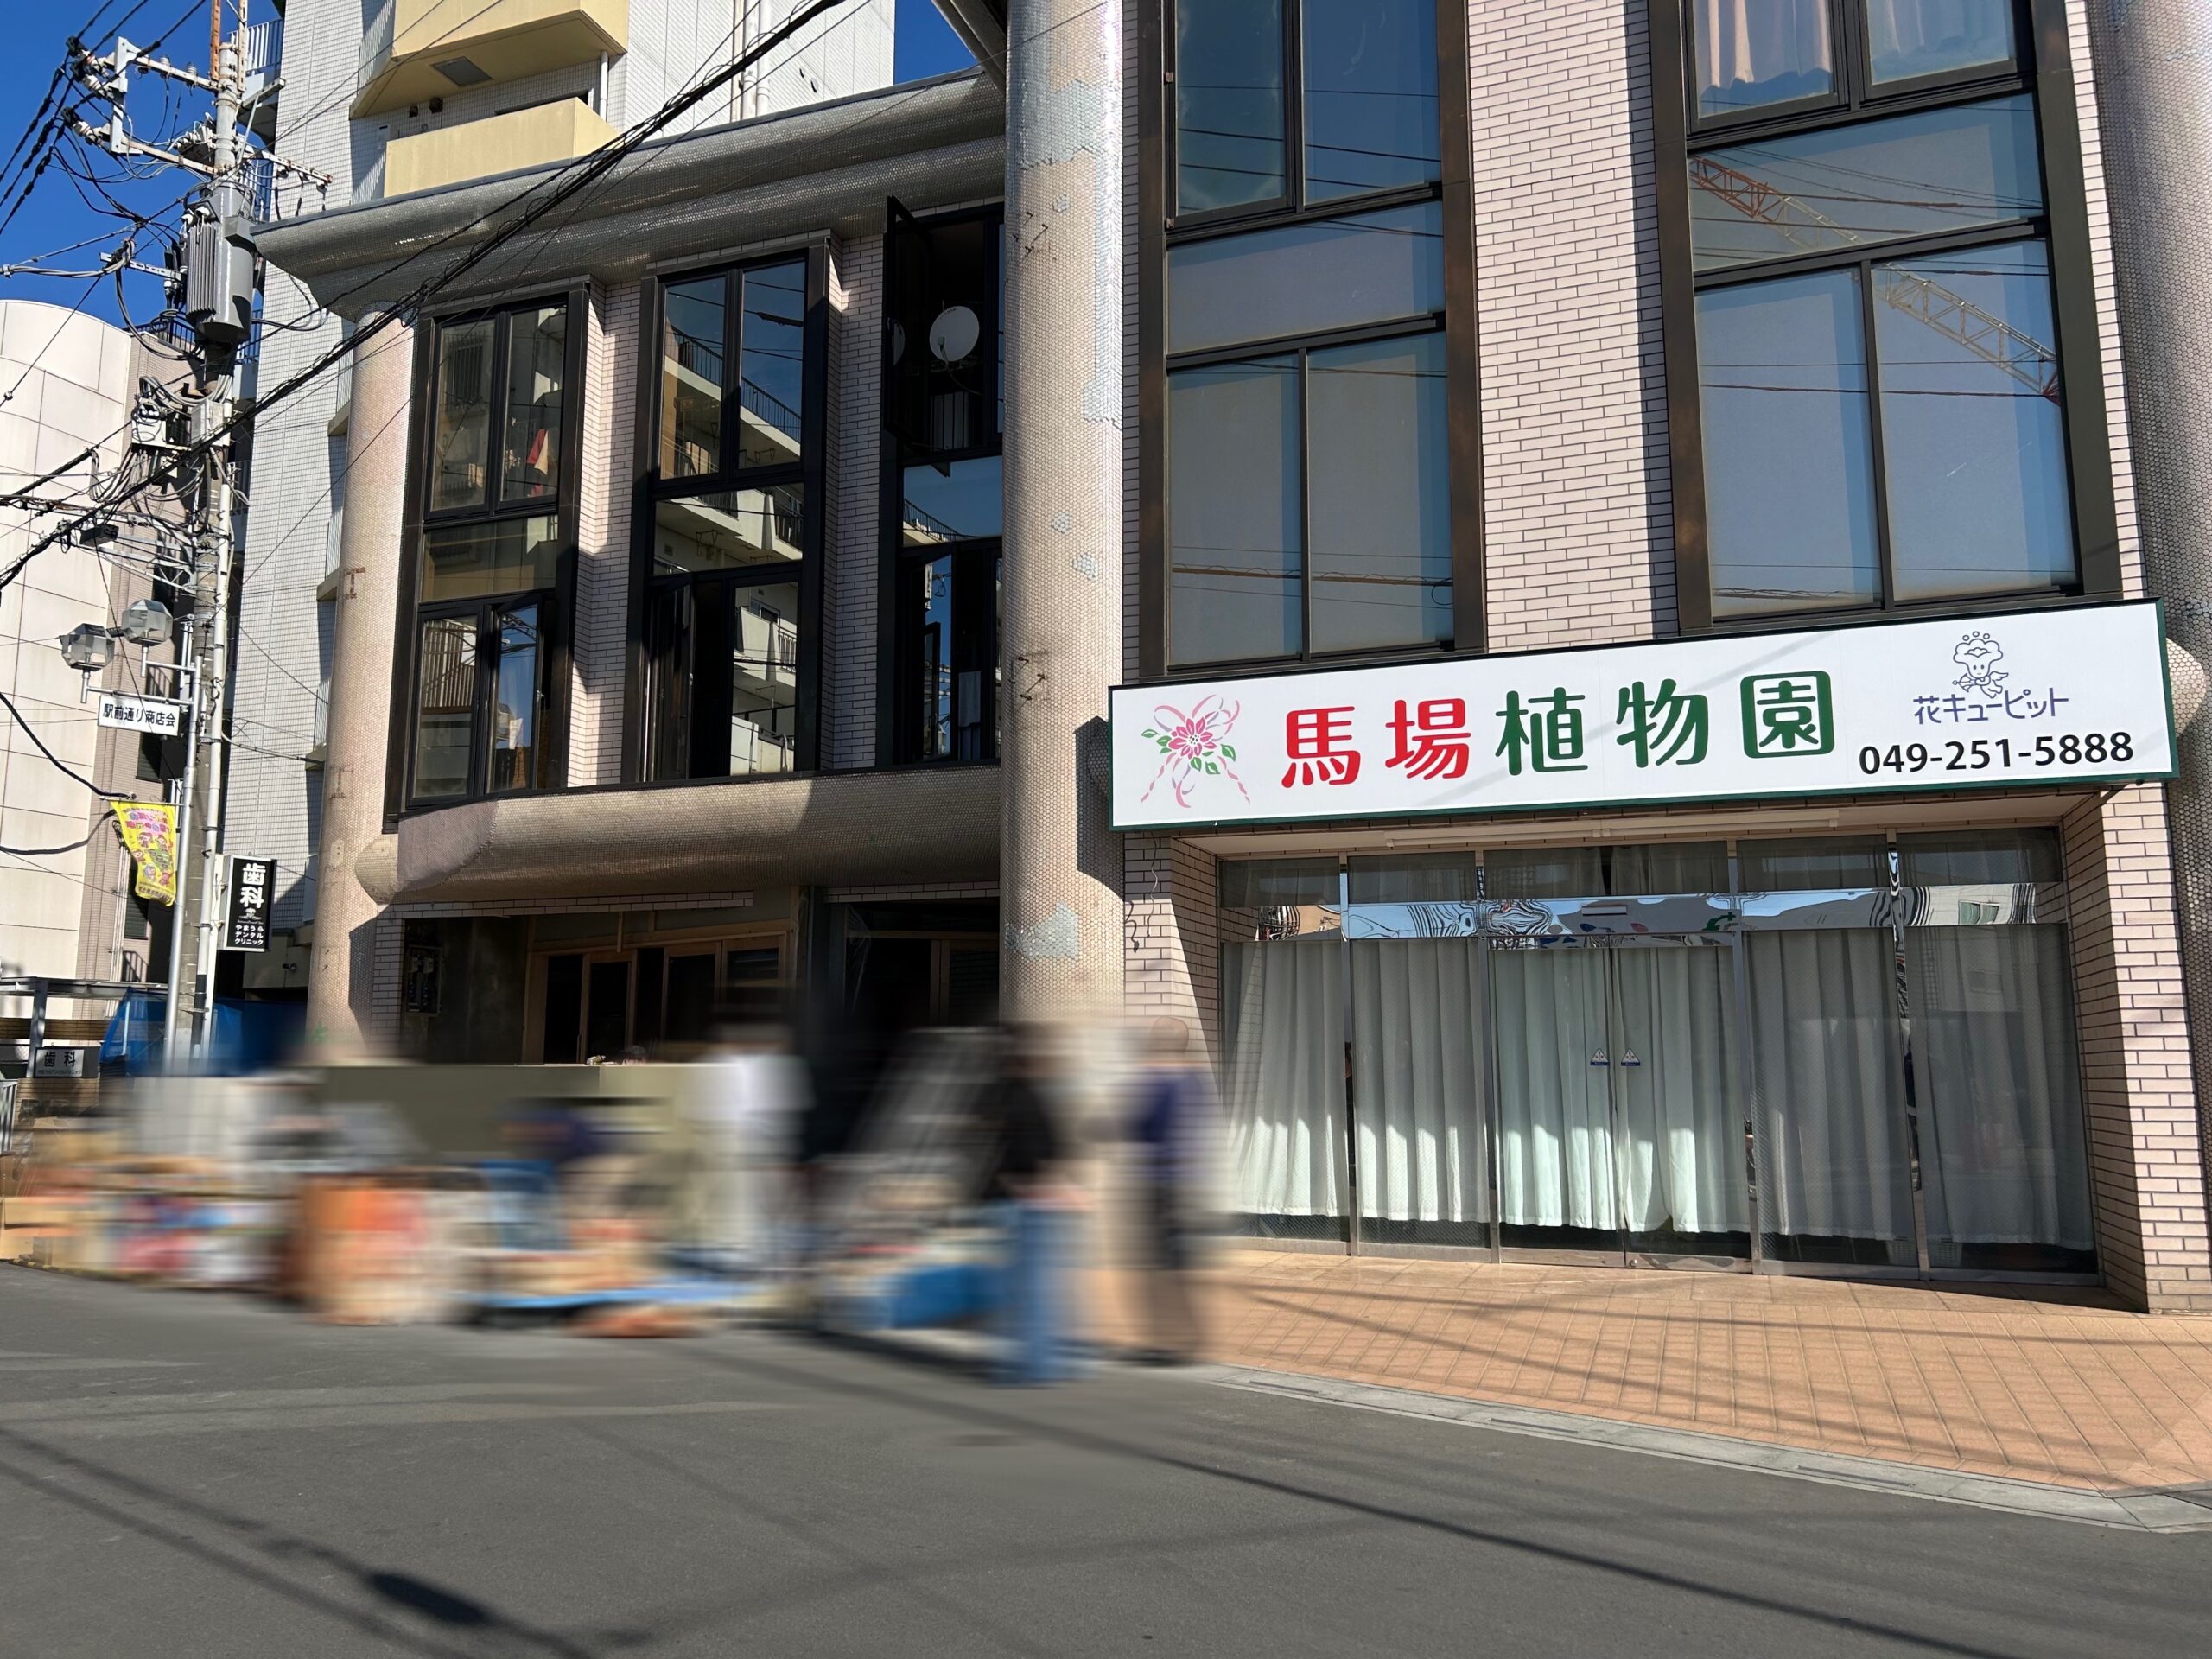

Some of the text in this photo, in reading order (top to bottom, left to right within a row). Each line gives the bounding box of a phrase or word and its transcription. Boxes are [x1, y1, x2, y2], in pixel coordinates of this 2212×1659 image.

[103, 703, 176, 728] 駅前通り商店会
[1912, 688, 2069, 725] 花キューピット
[1281, 670, 1835, 789] 馬場植物園
[1859, 731, 2134, 775] 049-251-5888
[240, 863, 266, 908] 歯科
[44, 1051, 75, 1067] 歯科
